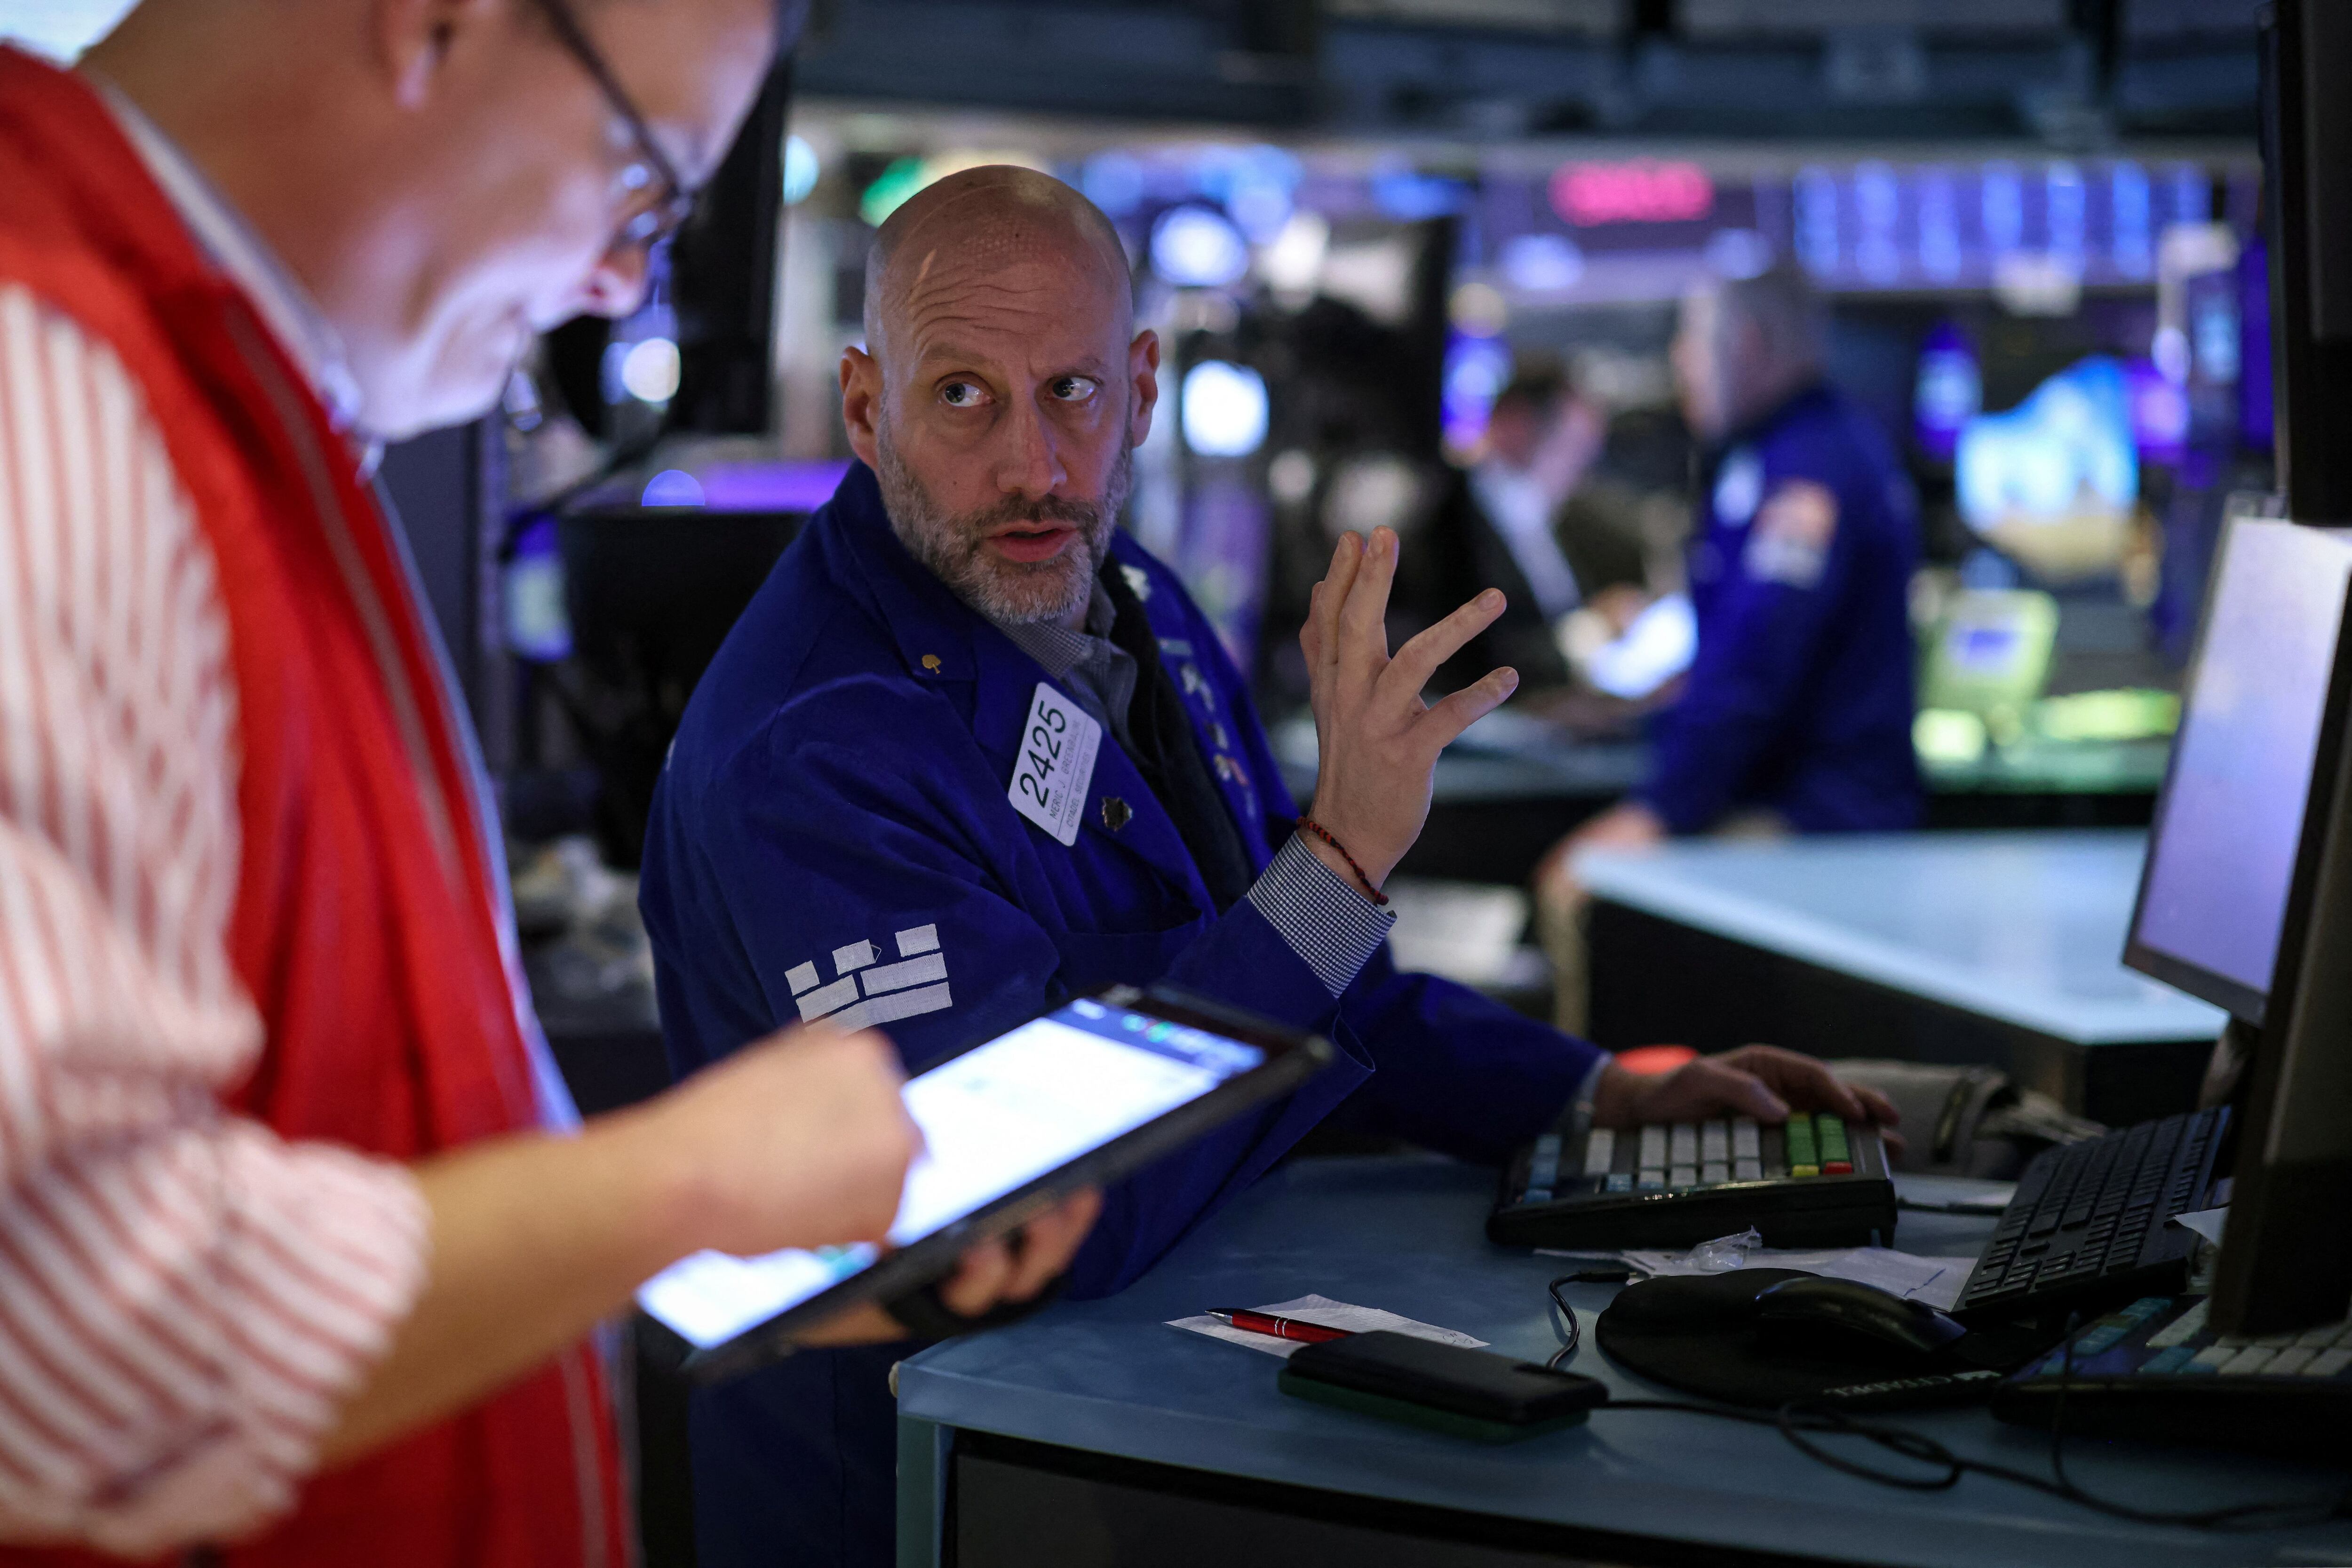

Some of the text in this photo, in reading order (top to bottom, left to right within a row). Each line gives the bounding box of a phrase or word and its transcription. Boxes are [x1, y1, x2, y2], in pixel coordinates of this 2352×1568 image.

[1019, 700, 1065, 808] 2425
[1049, 790, 1063, 820] MERIC
[1059, 780, 1065, 788] J
[1066, 796, 1080, 828] CITADEL
